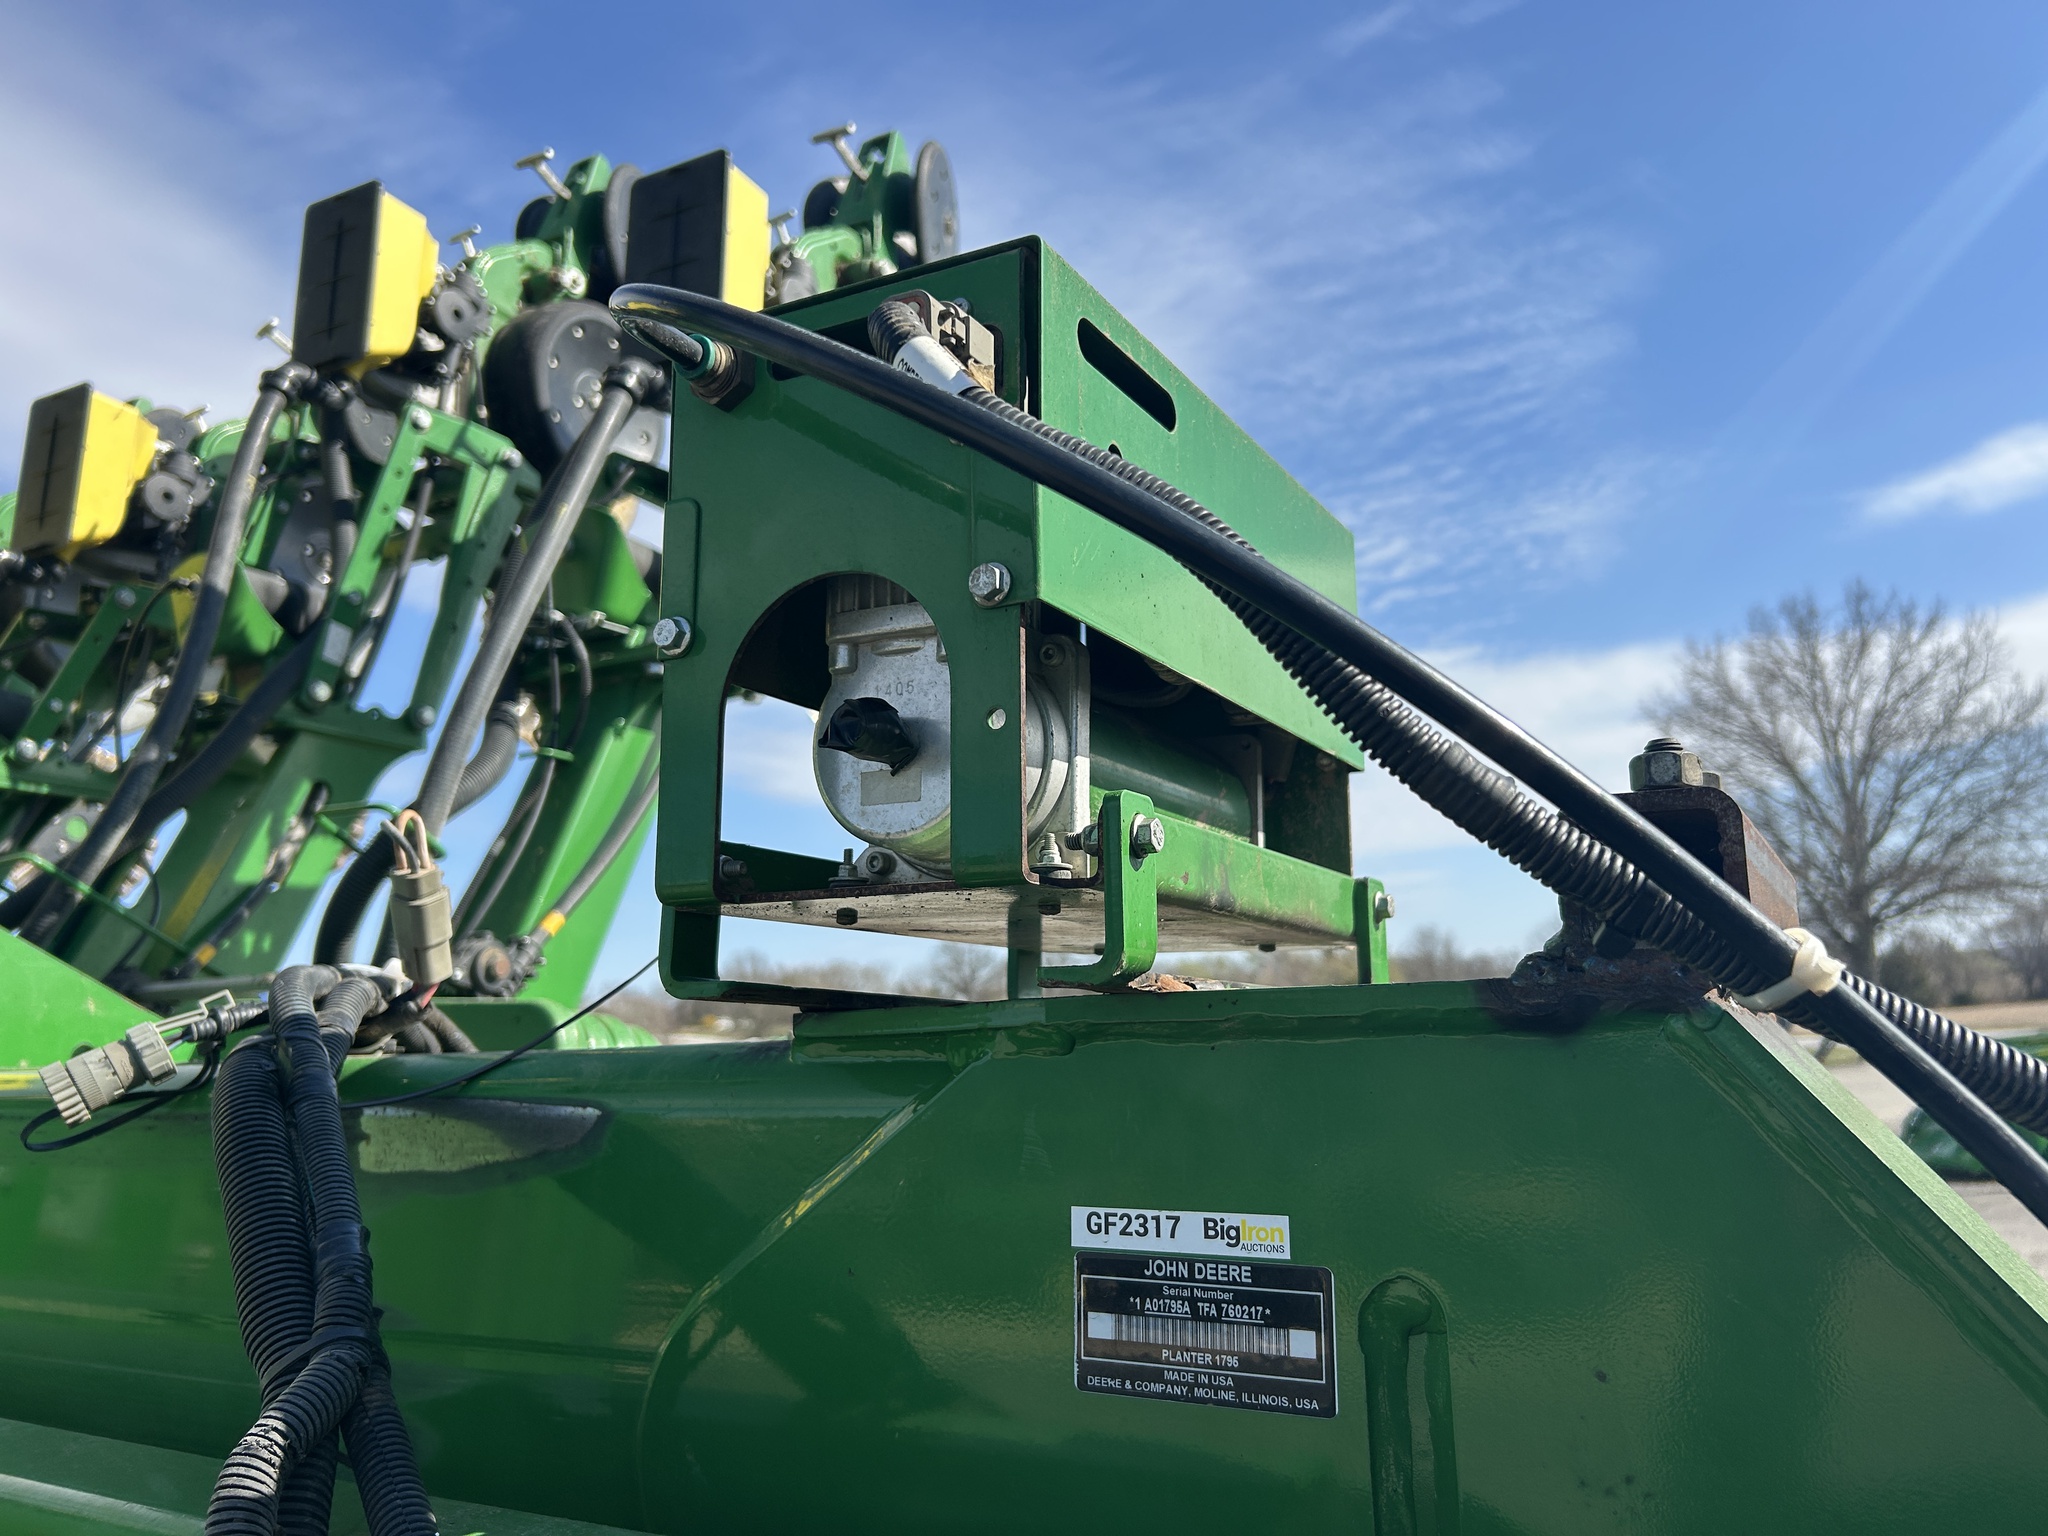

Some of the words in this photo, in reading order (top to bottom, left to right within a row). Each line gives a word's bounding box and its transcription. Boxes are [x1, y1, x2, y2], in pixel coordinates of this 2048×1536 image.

[1086, 1211, 1181, 1239] GF2317
[1203, 1217, 1285, 1248] BigIron
[1240, 1243, 1285, 1254] AUCTIONS
[1144, 1259, 1189, 1279] JOHN
[1195, 1263, 1252, 1283] DEERE
[1162, 1285, 1191, 1297] Serial
[1193, 1288, 1234, 1301] Number
[1144, 1298, 1191, 1314] A01795A
[1197, 1302, 1218, 1317] TFA
[1161, 1349, 1213, 1366] PLANTER
[1164, 1370, 1195, 1383] MADE
[1197, 1373, 1209, 1384] IN
[1211, 1375, 1234, 1387] USA
[1087, 1376, 1122, 1389] DEERE
[1124, 1380, 1132, 1390] &
[1134, 1380, 1192, 1398] COMPANY,
[1194, 1388, 1239, 1402] MOLINE,
[1241, 1392, 1292, 1408] ILLINOIS,
[1295, 1398, 1319, 1410] USA
